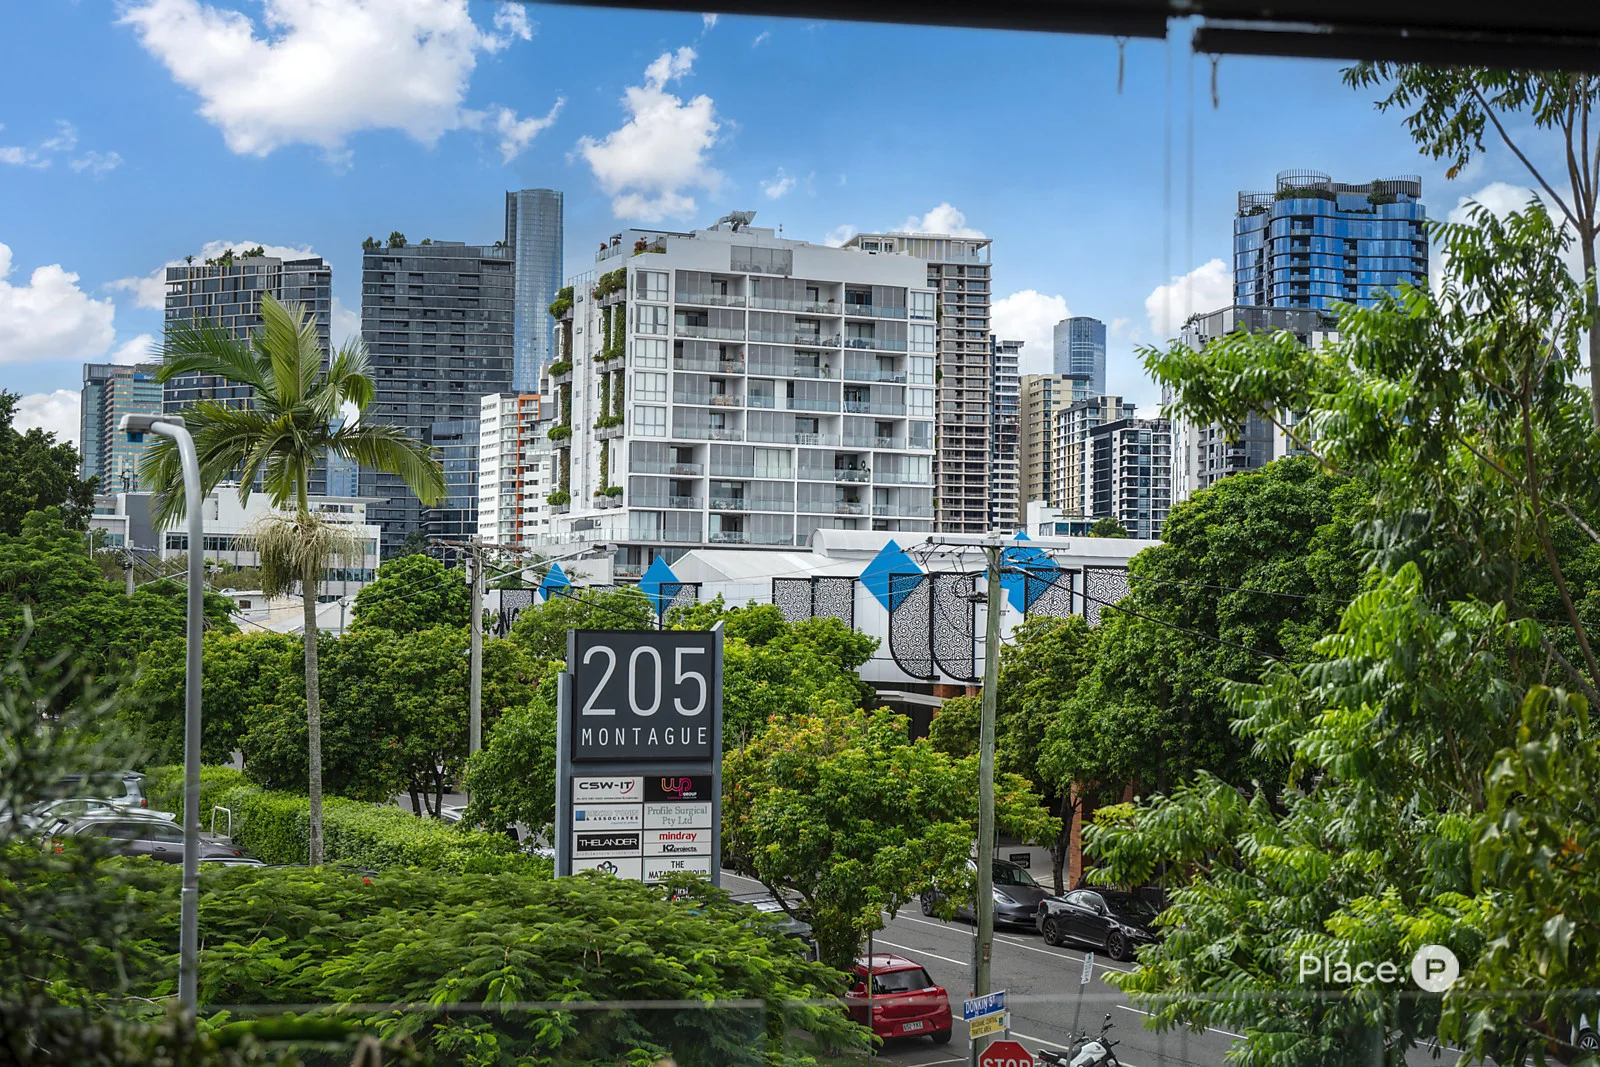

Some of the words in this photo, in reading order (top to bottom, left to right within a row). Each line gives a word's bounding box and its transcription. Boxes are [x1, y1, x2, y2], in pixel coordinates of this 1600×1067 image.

[582, 645, 707, 716] 205
[581, 727, 707, 746] MONTAGUE
[579, 781, 633, 790] CSW-IT
[647, 806, 674, 815] Profile
[675, 805, 708, 817] Surgical
[662, 817, 675, 826] Pty
[680, 816, 693, 825] Ltd
[659, 832, 697, 842] mindray
[579, 838, 638, 847] THELANDER
[671, 861, 685, 869] THE
[965, 998, 988, 1014] DONKIN
